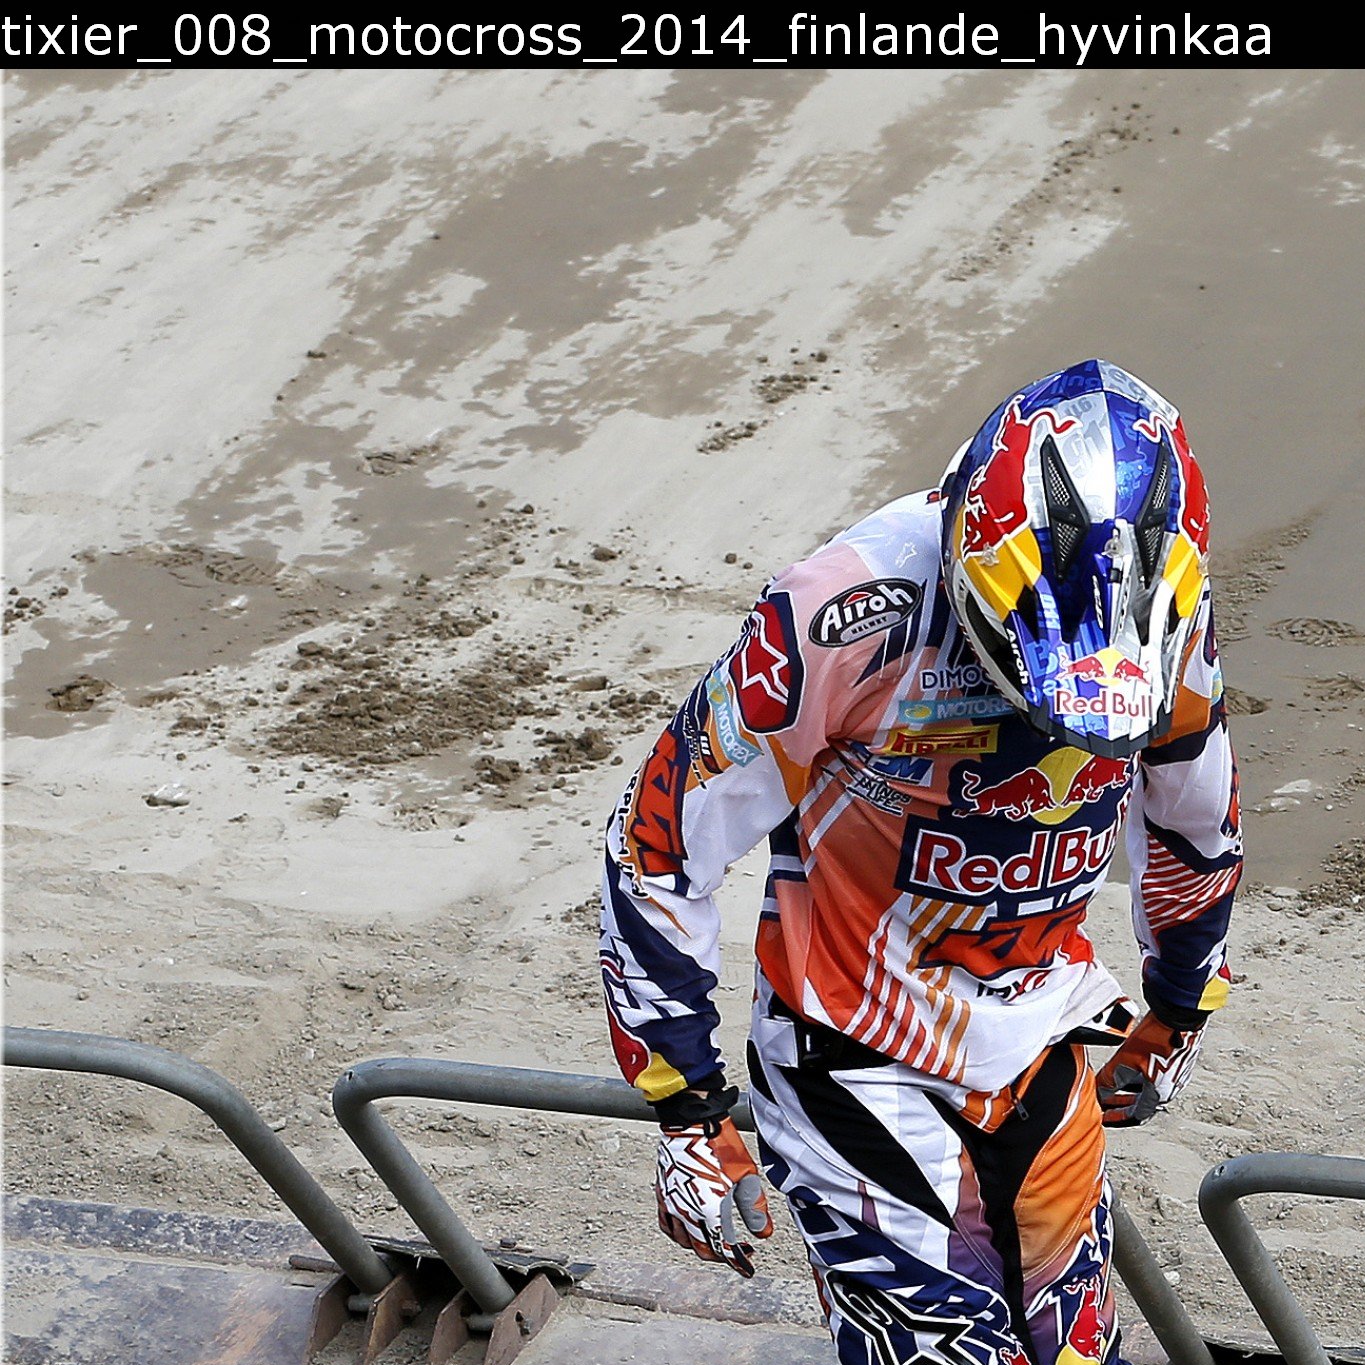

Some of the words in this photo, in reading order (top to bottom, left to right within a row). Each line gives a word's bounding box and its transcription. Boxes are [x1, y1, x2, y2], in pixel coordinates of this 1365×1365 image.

[821, 584, 914, 641] Airoh
[1006, 627, 1029, 685] Airoh
[717, 703, 755, 764] MOTOREX
[1055, 690, 1107, 714] Red
[1112, 692, 1153, 719] Bull
[911, 830, 1050, 894] Red
[1050, 808, 1122, 886] Bu
